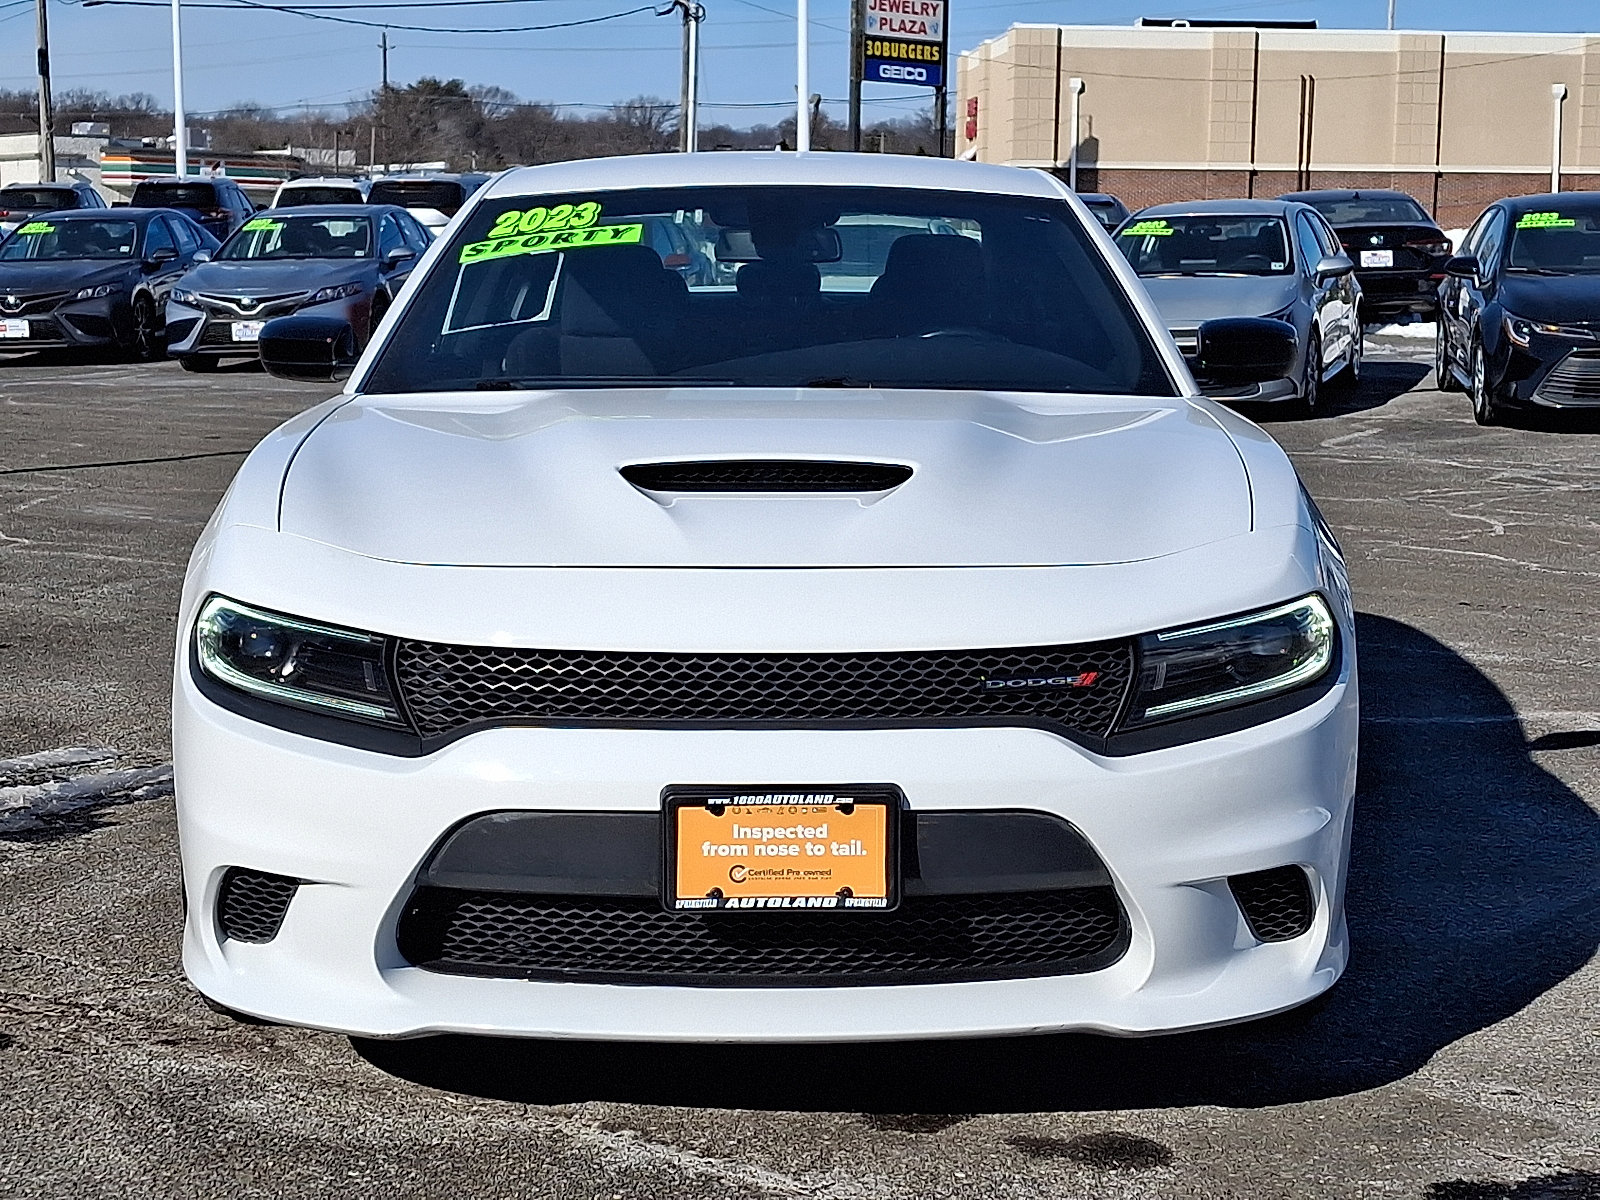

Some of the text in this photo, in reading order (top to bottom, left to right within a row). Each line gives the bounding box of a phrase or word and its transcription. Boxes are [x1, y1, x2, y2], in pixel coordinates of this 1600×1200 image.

[868, 0, 940, 17] JEWELRY
[879, 17, 928, 35] PLAZA
[866, 40, 940, 61] 30BURGERS
[879, 65, 927, 81] GEICO
[487, 201, 602, 239] 2023
[464, 226, 636, 258] SPORTY
[985, 676, 1083, 689] DODGE
[732, 823, 828, 842] Inspected
[701, 840, 867, 856] from nose to tail.
[724, 898, 838, 908] AUTOLAND
